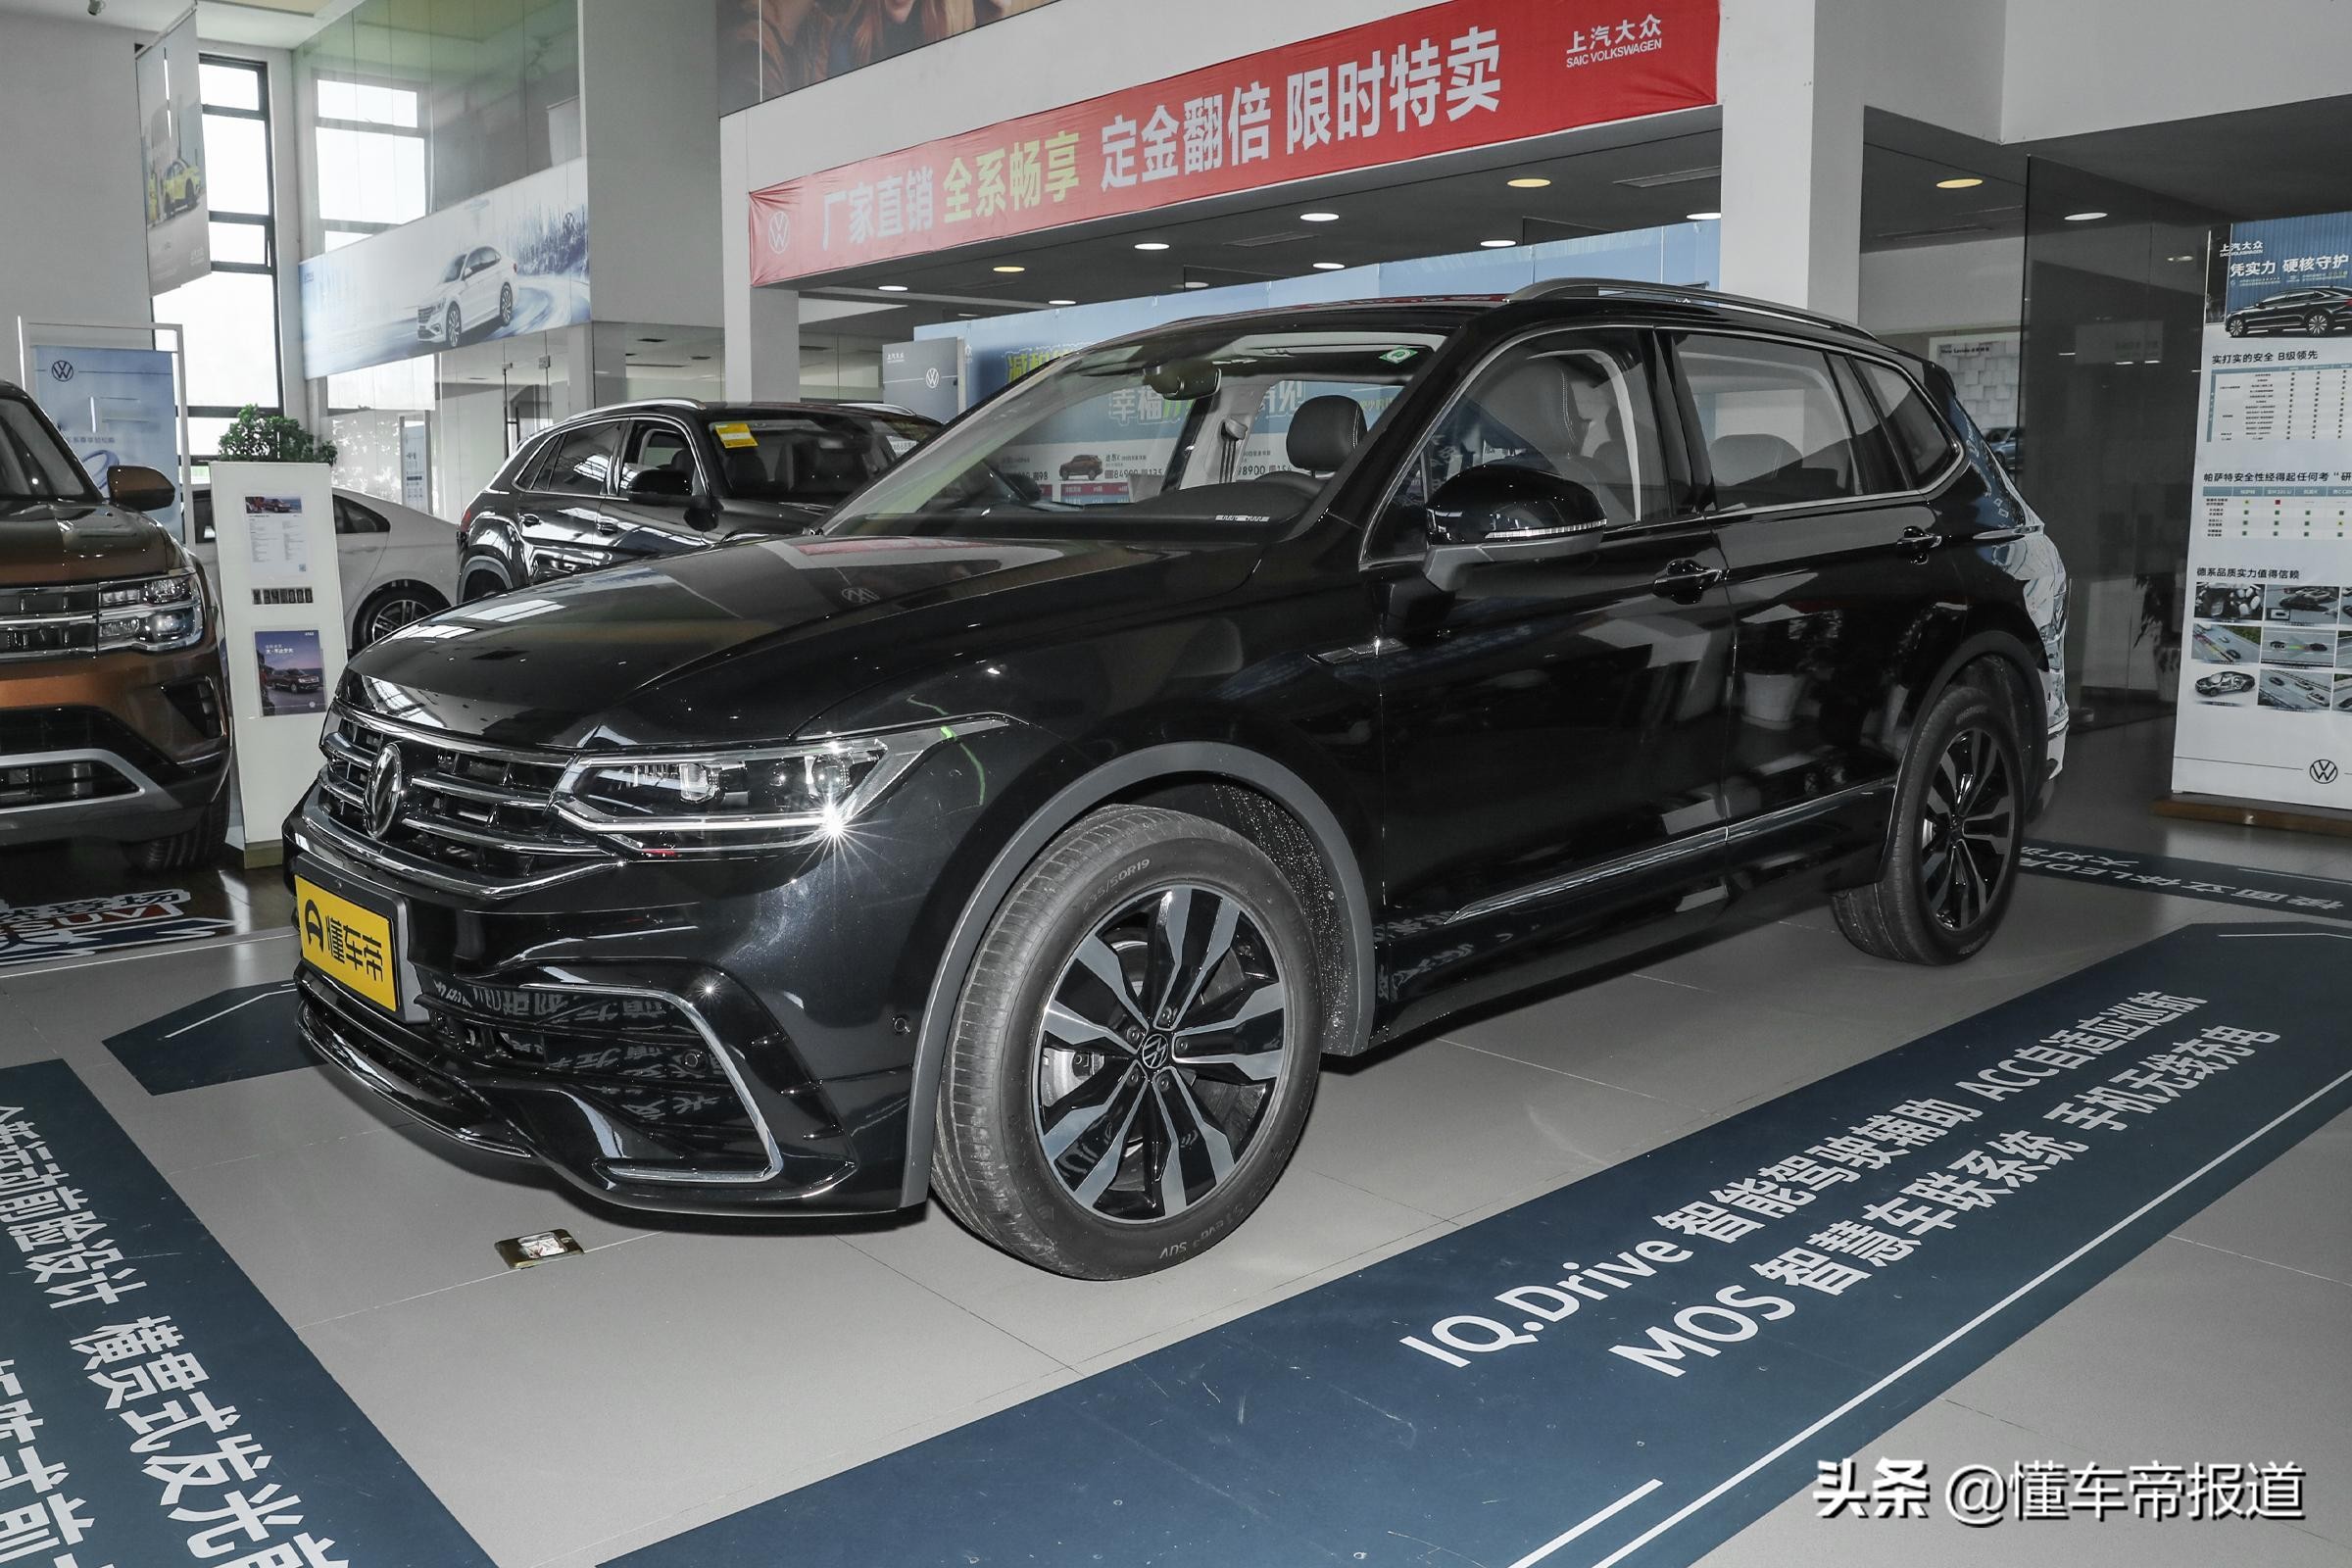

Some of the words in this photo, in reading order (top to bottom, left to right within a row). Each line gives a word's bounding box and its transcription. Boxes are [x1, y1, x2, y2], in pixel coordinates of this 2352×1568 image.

[1566, 54, 1589, 69] SAIC
[1591, 38, 1662, 63] VOLKSWAGEN
[1567, 14, 1662, 55] 上汽大众
[820, 169, 935, 252] 厂家直销
[942, 130, 1080, 224] 全系畅享
[1101, 80, 1272, 192] 定金翻倍
[1286, 25, 1501, 155] 限时特卖
[2230, 260, 2277, 277] 凭实力
[2281, 254, 2349, 273] 硬核守护
[2212, 352, 2274, 365] 实打实的安全
[2278, 350, 2319, 361] B级领先
[2196, 567, 2300, 580] 德系品质实力值得信赖
[325, 914, 384, 983] 懂车帝
[1399, 1239, 1694, 1368] IQ.Drive
[1652, 1098, 1983, 1244] 智能驾驶辅助
[1955, 991, 2208, 1102] ACC自适应巡航
[1608, 1284, 1796, 1378] MOS
[1750, 1129, 2090, 1296] 智慧车联系统
[2042, 1025, 2281, 1131] 手机无线充电
